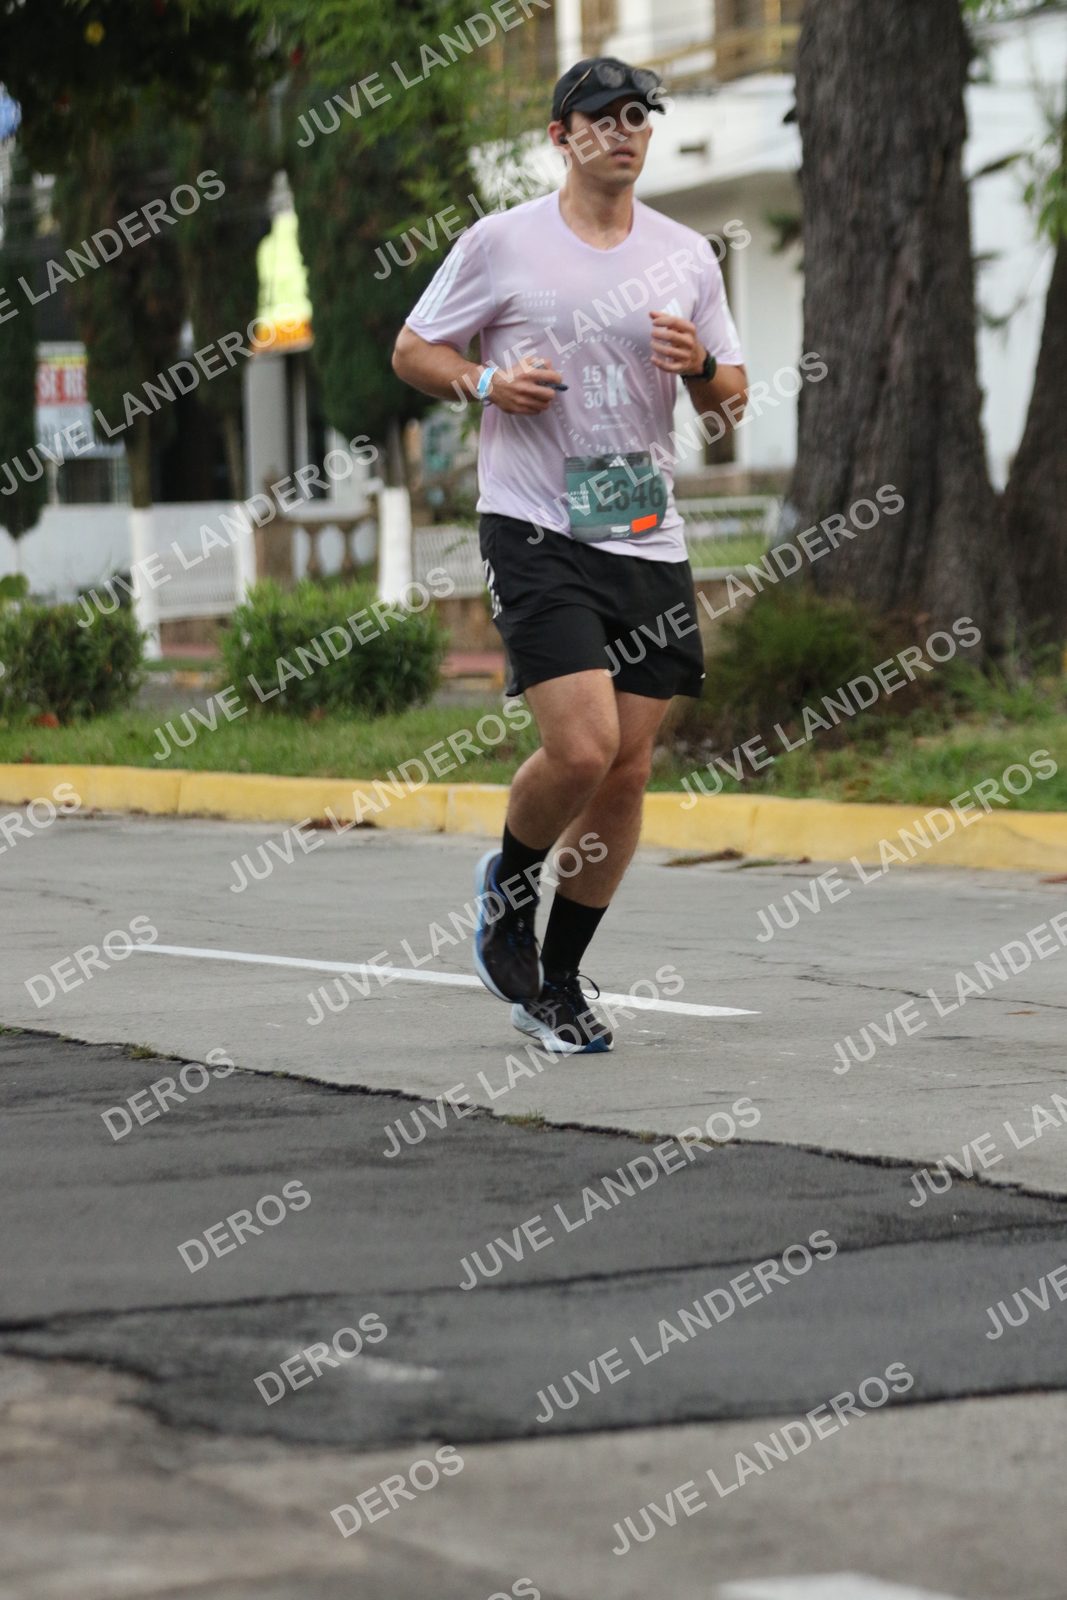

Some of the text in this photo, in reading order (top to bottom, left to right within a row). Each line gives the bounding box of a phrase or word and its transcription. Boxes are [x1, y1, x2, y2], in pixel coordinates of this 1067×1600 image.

[582, 364, 601, 384] 15
[584, 390, 604, 410] 30
[595, 476, 665, 513] 2646
